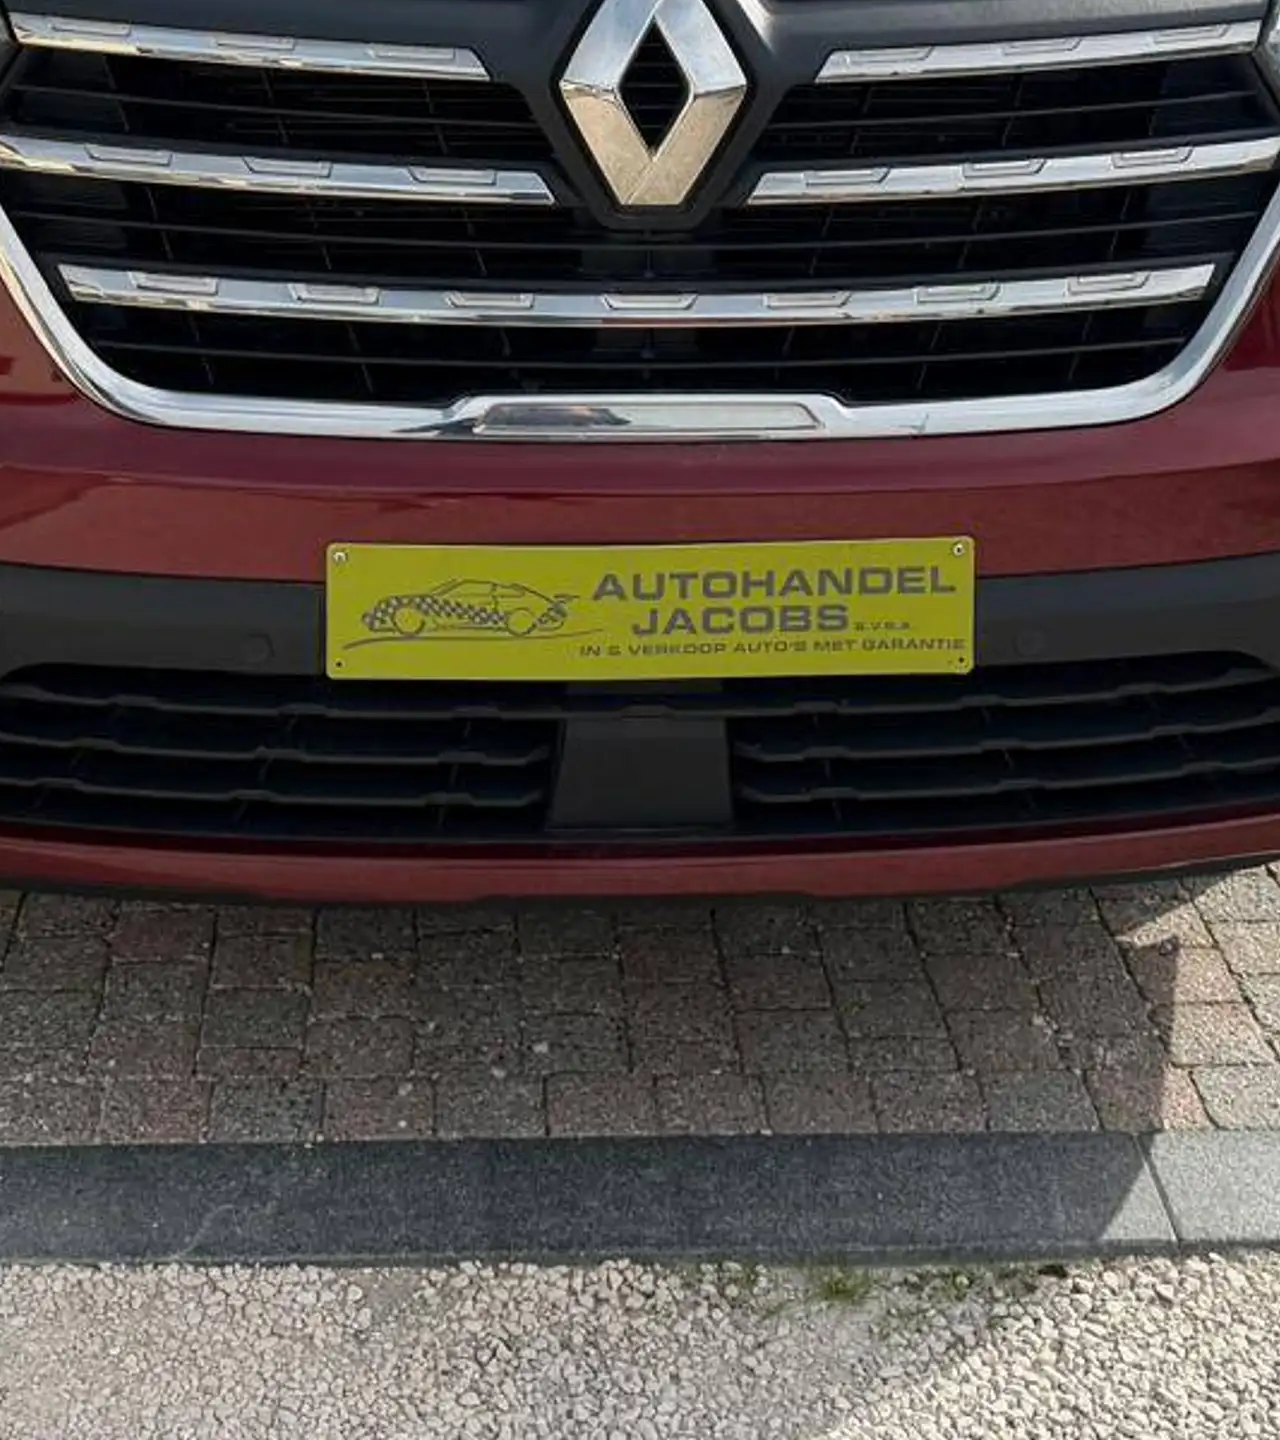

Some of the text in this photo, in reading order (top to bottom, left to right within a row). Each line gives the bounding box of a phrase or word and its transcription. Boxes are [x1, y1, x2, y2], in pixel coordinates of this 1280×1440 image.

[592, 566, 957, 601] AUTOHANDEL
[631, 604, 848, 635] JACOBS
[580, 645, 601, 656] IN
[628, 642, 726, 655] VERKOOP
[734, 639, 808, 653] AUTO'S
[813, 639, 855, 652] MET
[862, 637, 967, 650] GARANTIE
